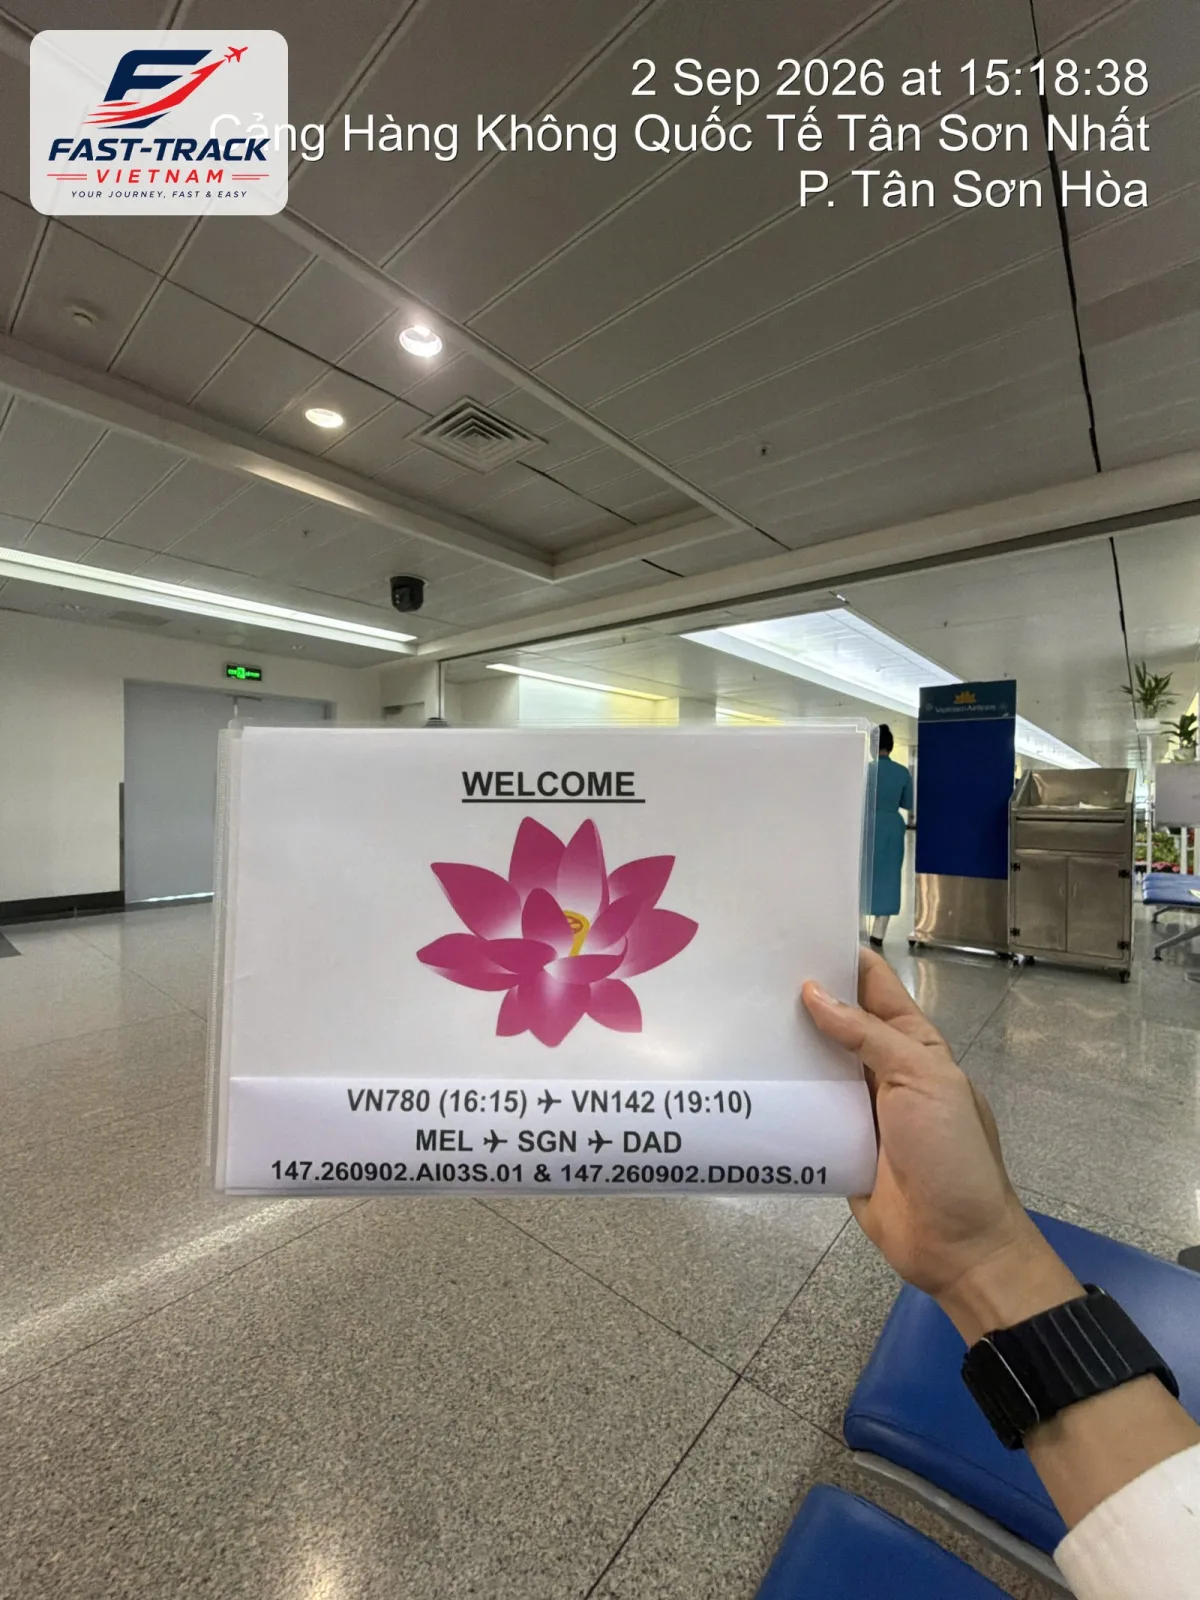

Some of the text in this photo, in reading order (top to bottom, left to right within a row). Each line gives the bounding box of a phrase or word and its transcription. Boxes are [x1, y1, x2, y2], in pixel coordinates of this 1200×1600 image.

[462, 771, 636, 798] WELCOME
[347, 1089, 752, 1120] VN780 (16:15) VN142 (19:10)
[415, 1129, 682, 1154] MEL SGN DAD
[270, 1160, 828, 1185] 147.260902.AI03S.01 & 147.260902.DD03S.01
